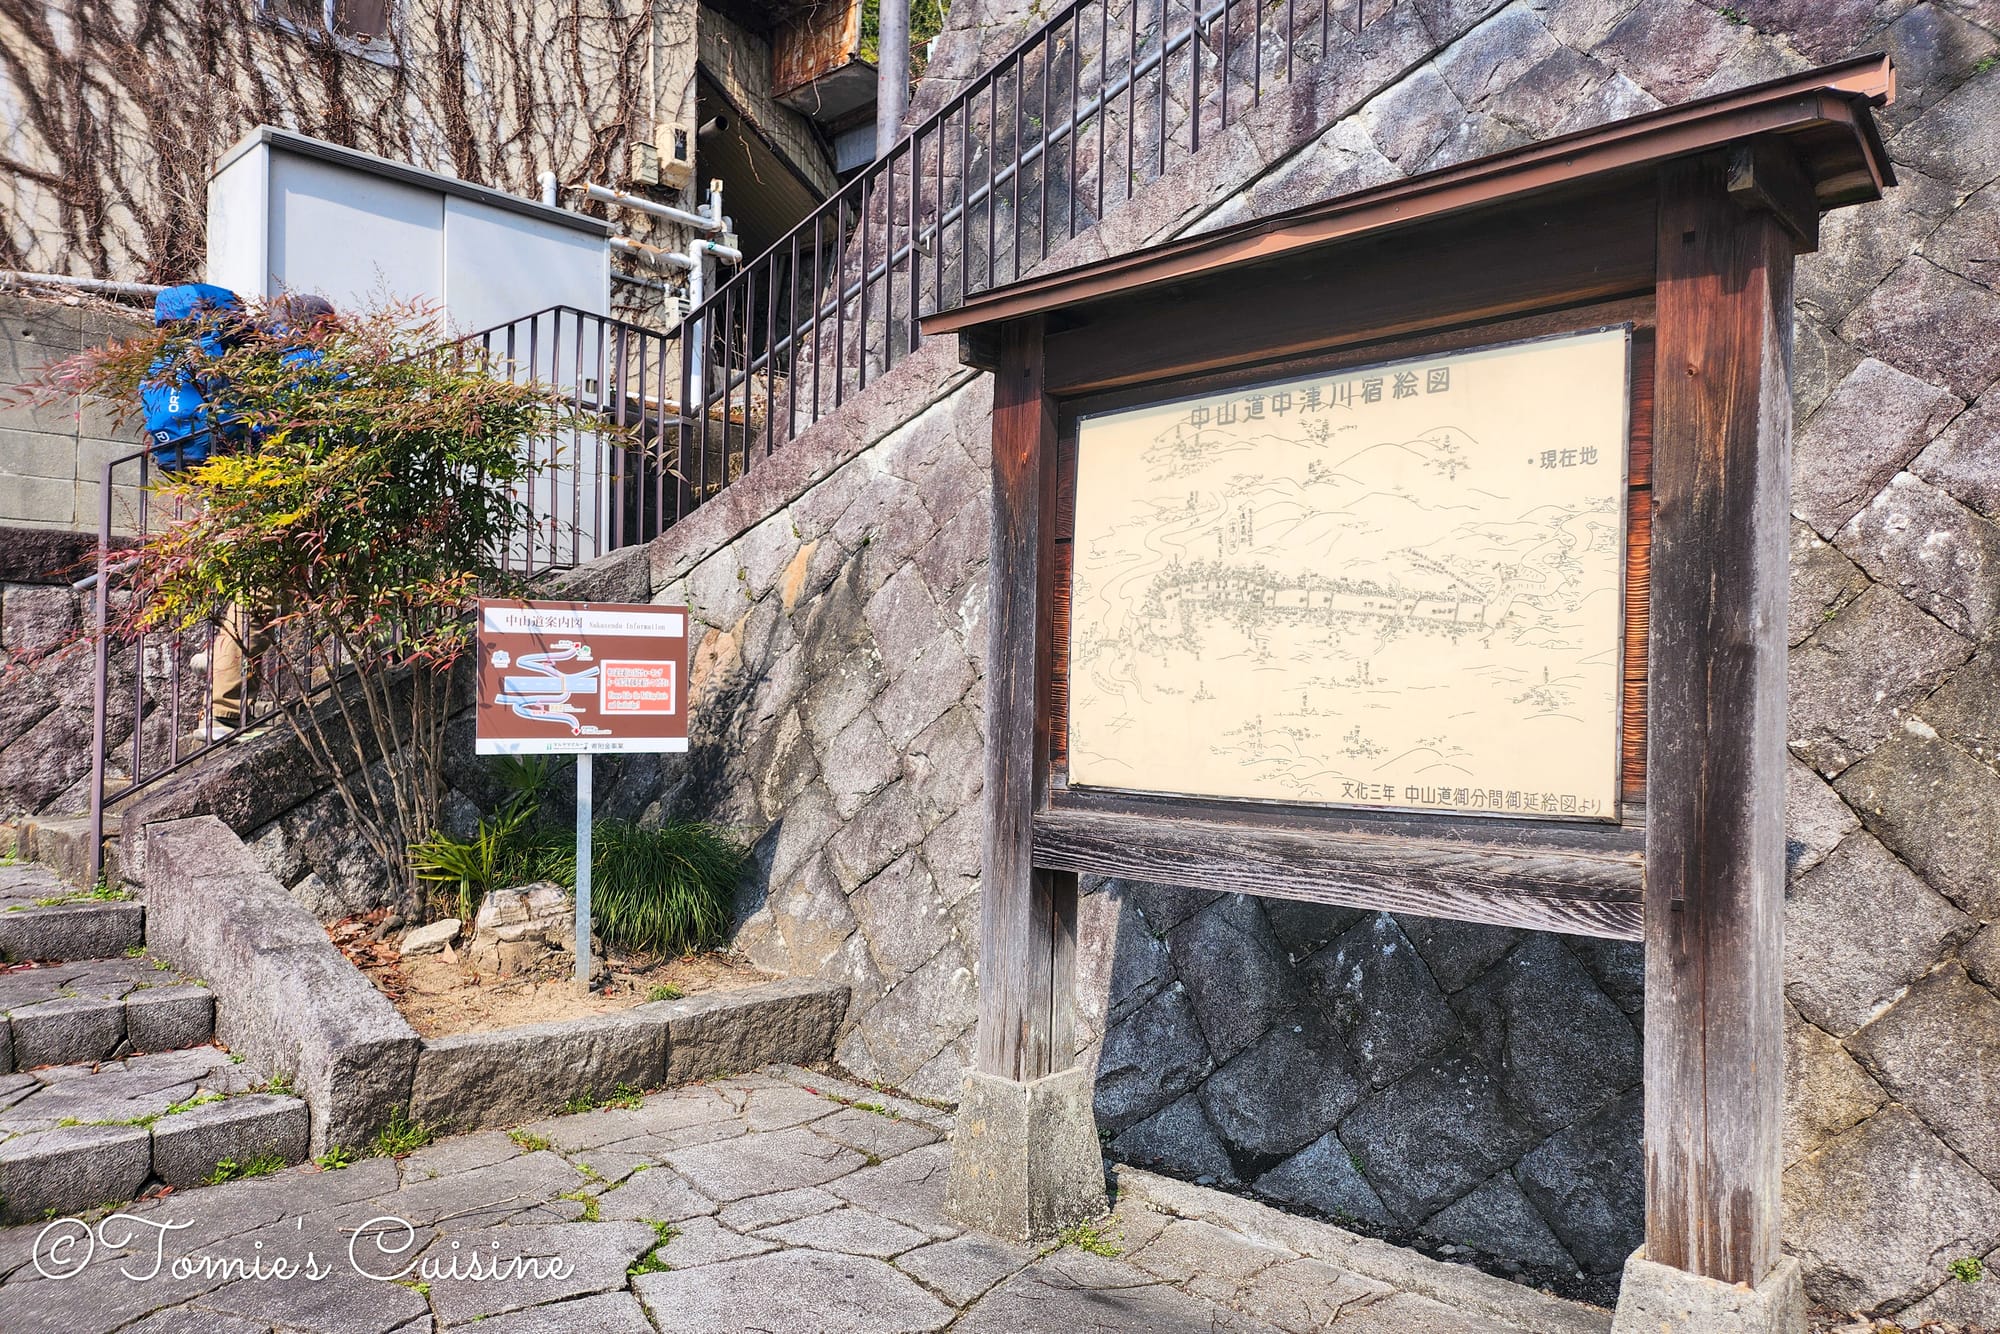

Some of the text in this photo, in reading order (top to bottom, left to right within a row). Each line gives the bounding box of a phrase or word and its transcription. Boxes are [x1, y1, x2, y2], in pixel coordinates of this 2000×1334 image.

[1191, 366, 1450, 430] 中山道中津川宿絵図
[1539, 445, 1599, 470] 現在地
[505, 614, 583, 629] 中山道案内図
[1341, 781, 1396, 803] 文化三年
